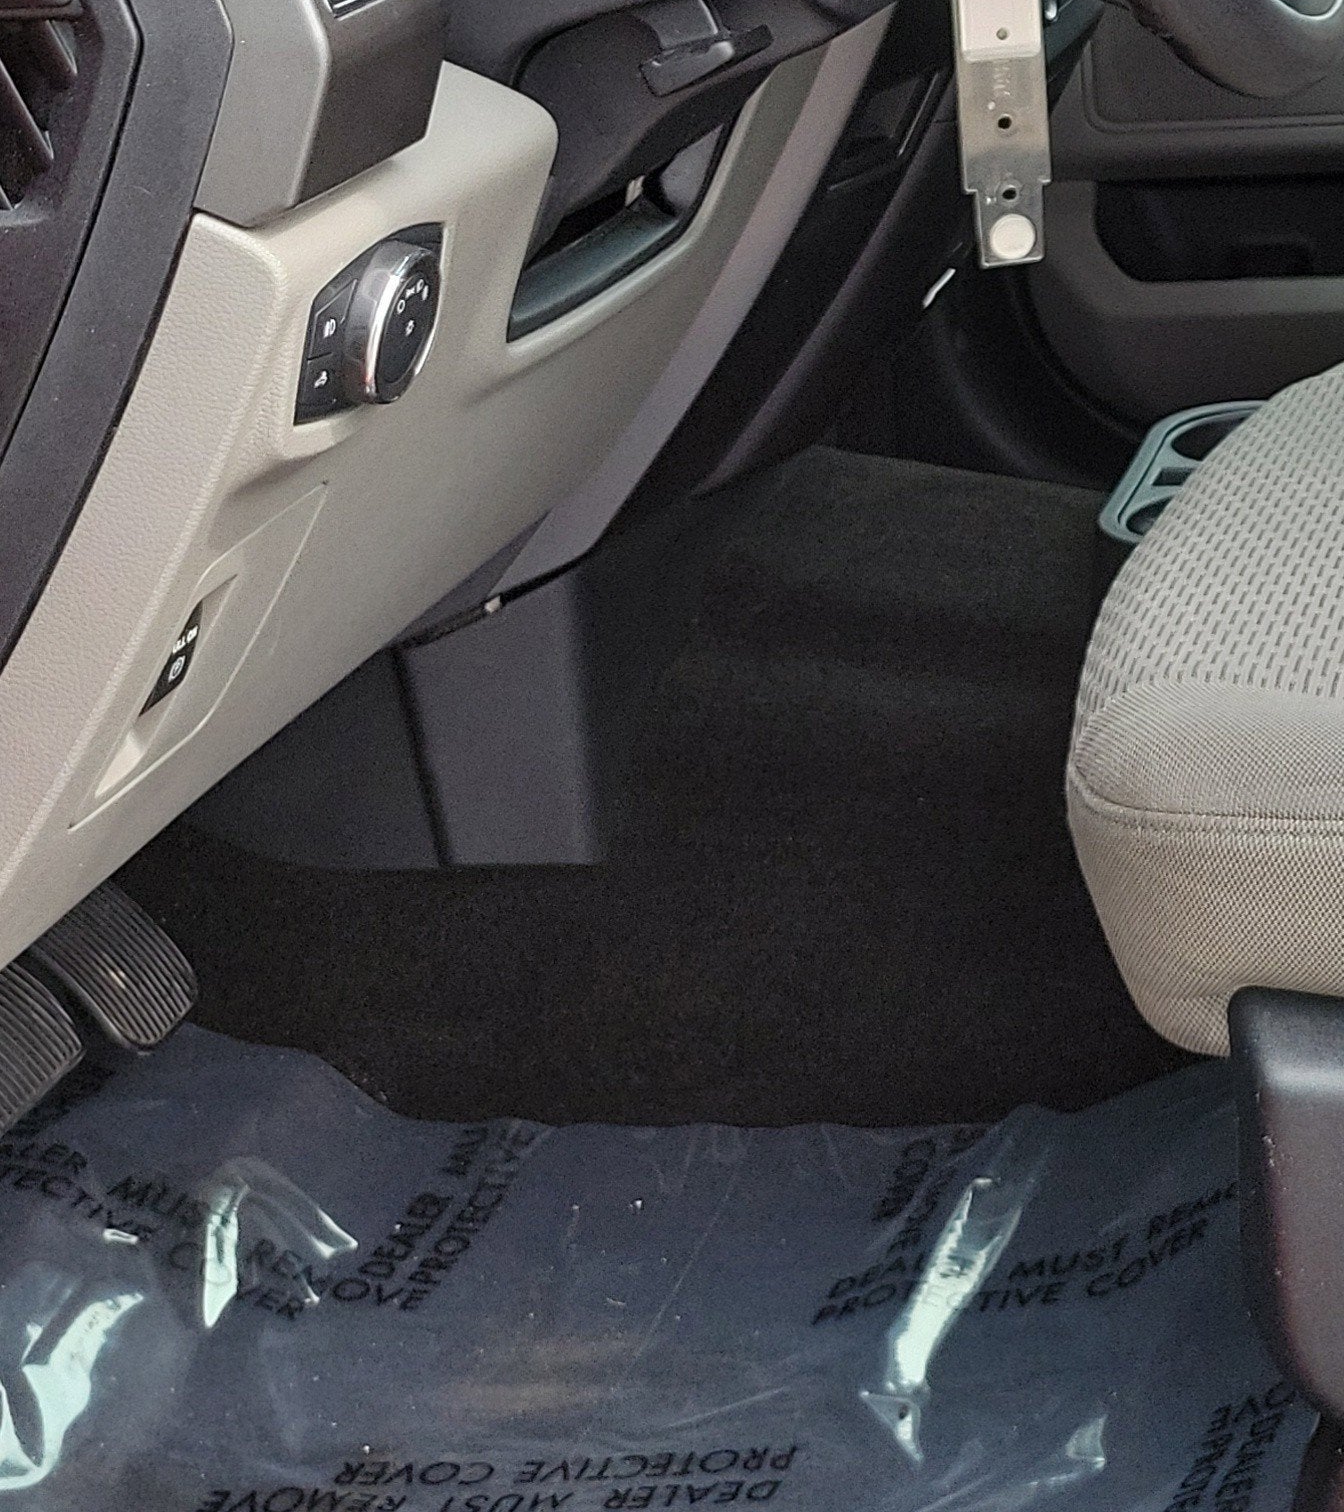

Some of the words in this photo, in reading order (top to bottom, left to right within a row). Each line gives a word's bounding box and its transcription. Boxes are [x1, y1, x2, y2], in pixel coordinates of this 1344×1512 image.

[333, 1460, 496, 1486] COVER
[512, 1444, 799, 1486] PROTECTIVE
[603, 1479, 784, 1510] DEALER
